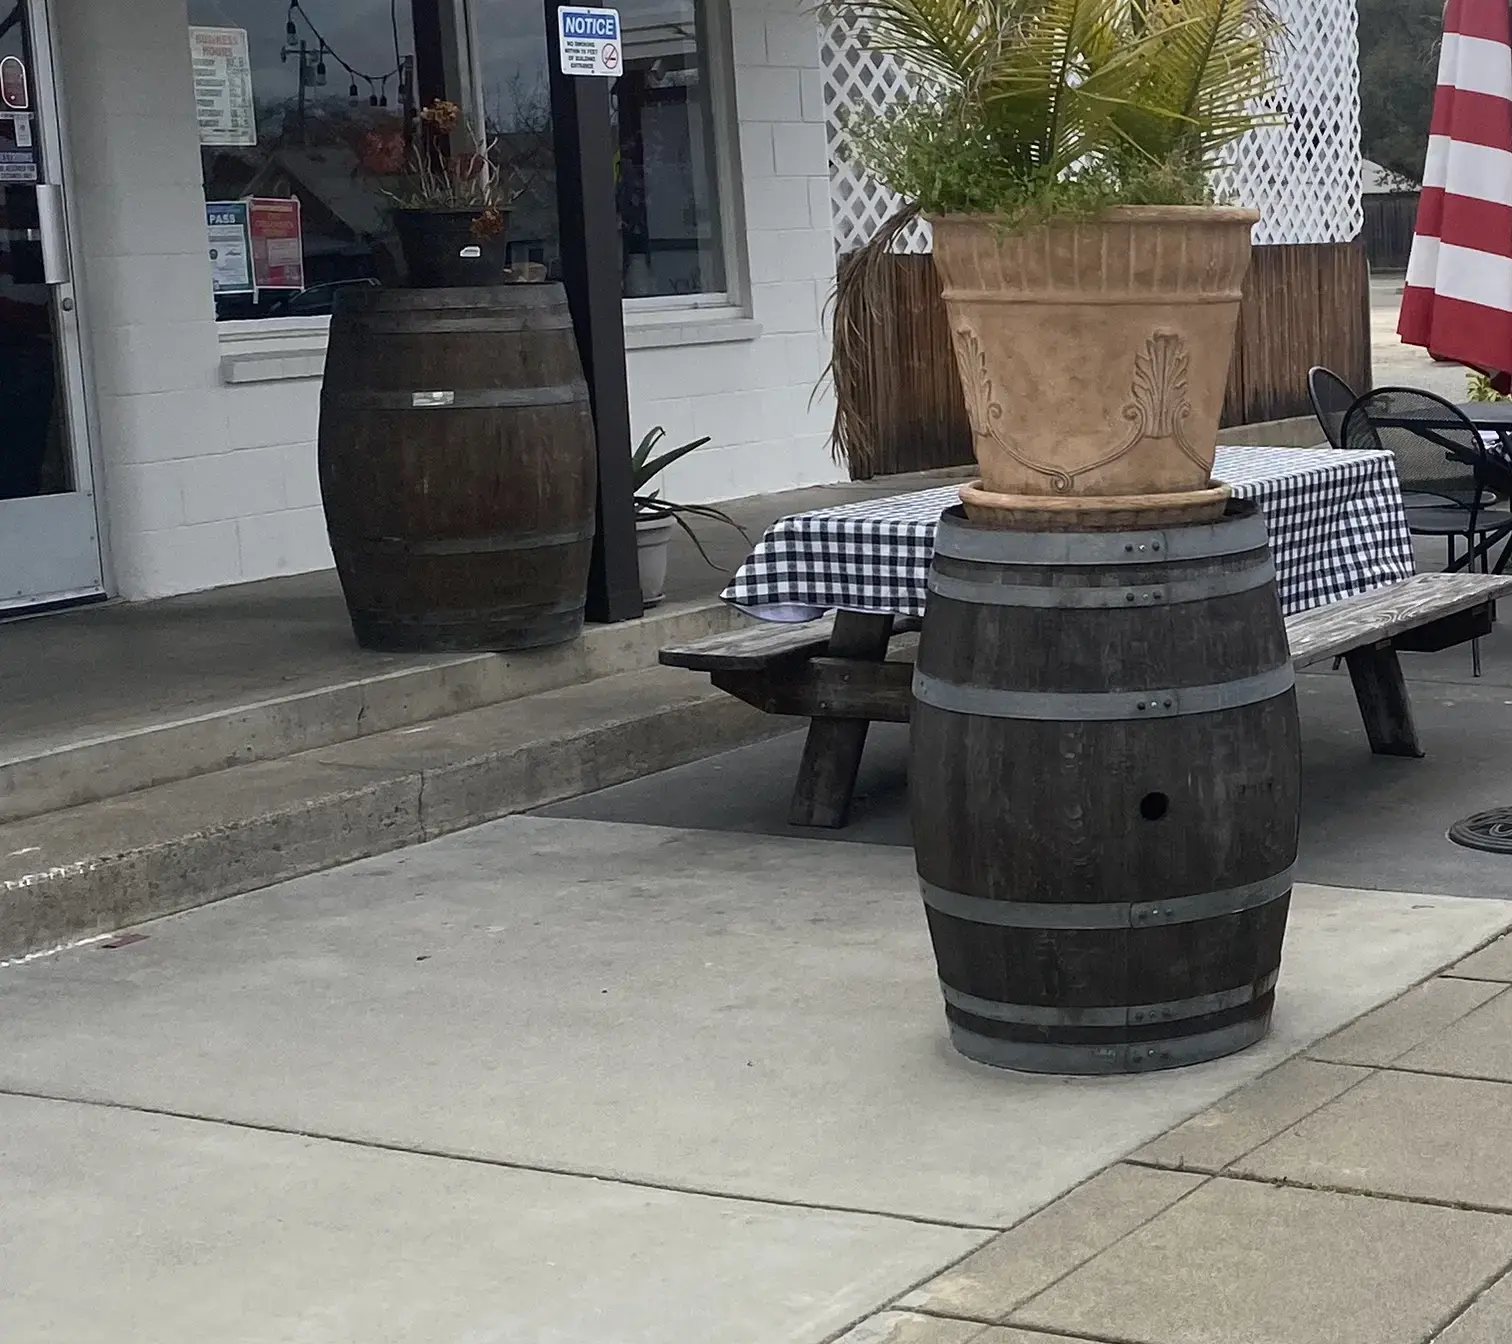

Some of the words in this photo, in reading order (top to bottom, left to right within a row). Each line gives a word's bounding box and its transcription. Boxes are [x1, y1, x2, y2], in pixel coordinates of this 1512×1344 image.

[565, 16, 614, 35] NOTICE
[202, 46, 233, 57] HOURS
[209, 214, 236, 224] PASS
